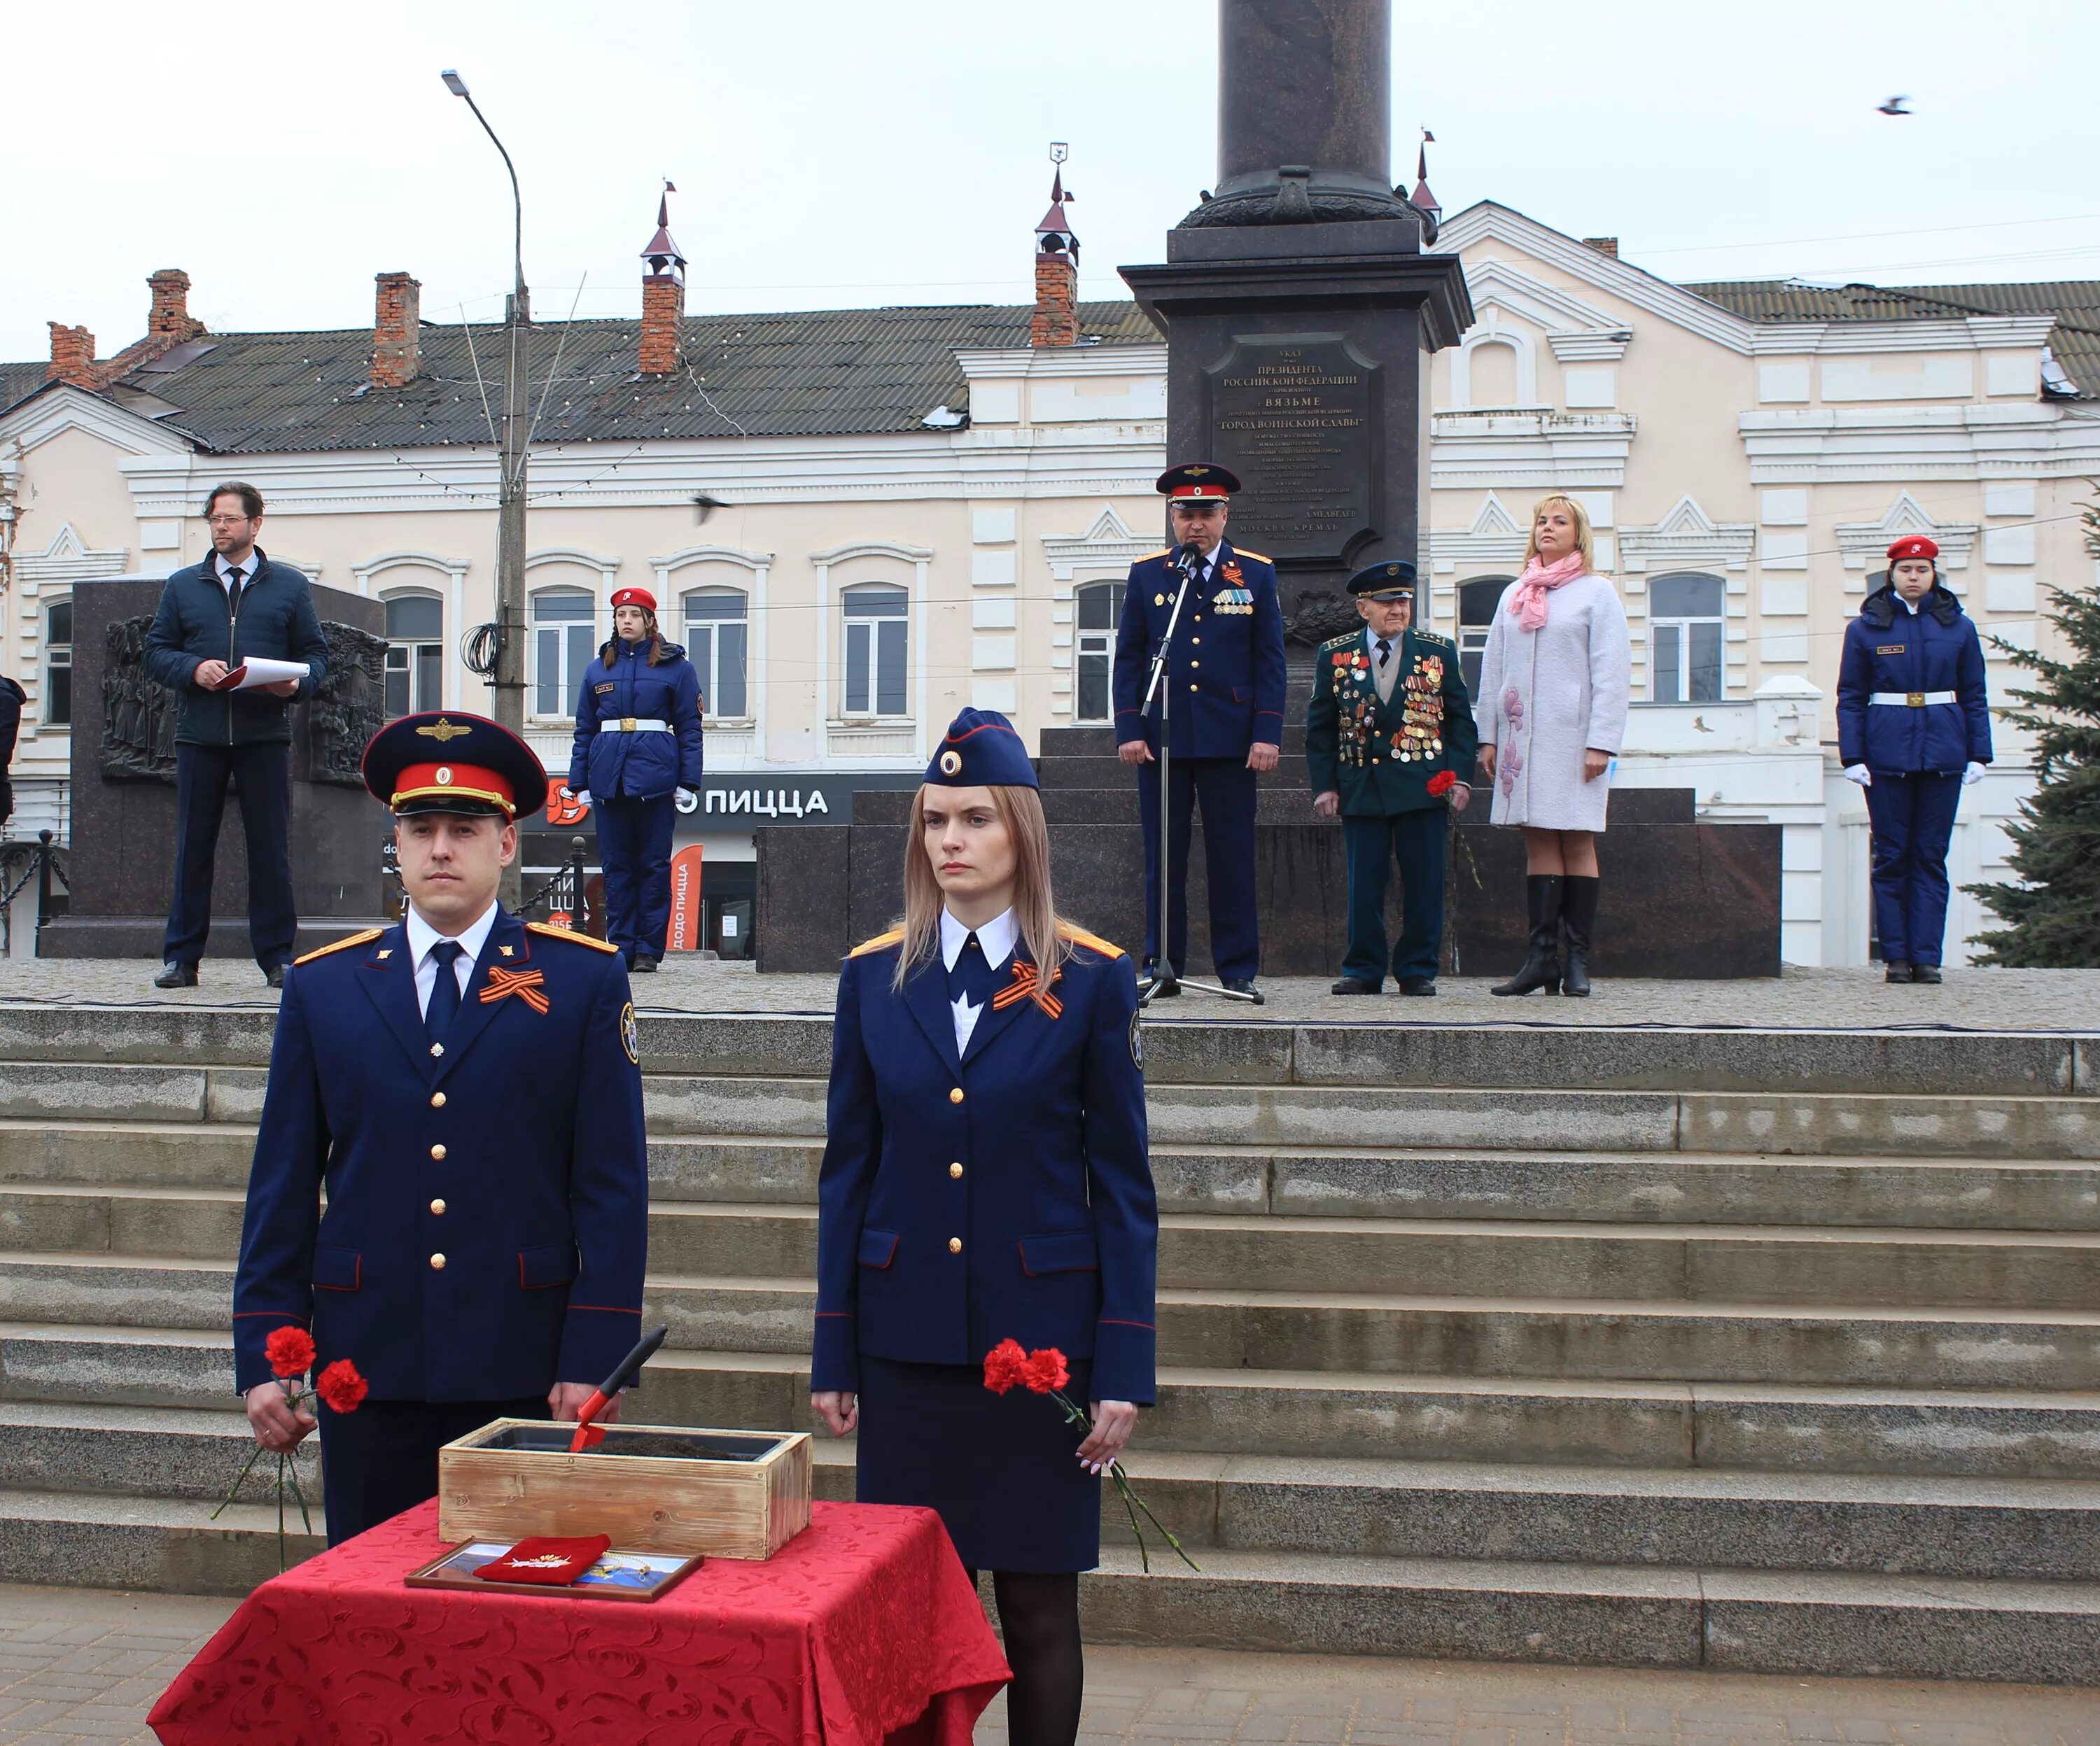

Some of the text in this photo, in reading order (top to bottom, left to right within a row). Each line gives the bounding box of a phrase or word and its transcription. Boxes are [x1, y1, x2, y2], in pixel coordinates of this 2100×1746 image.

[1258, 365, 1322, 374] ПРЕЗИДЕНТА
[1224, 376, 1357, 386] РОССИЙСКОЙ ФЕДЕРАЦИИ
[1266, 397, 1321, 407] ВЯЗЬМЕ
[1257, 418, 1320, 429] ВОИНСКОЙ
[1294, 523, 1338, 532] КРЕМЛЬ
[705, 789, 829, 819] ПИЦЦА
[673, 864, 688, 950] ДОДО ПИЦЦА
